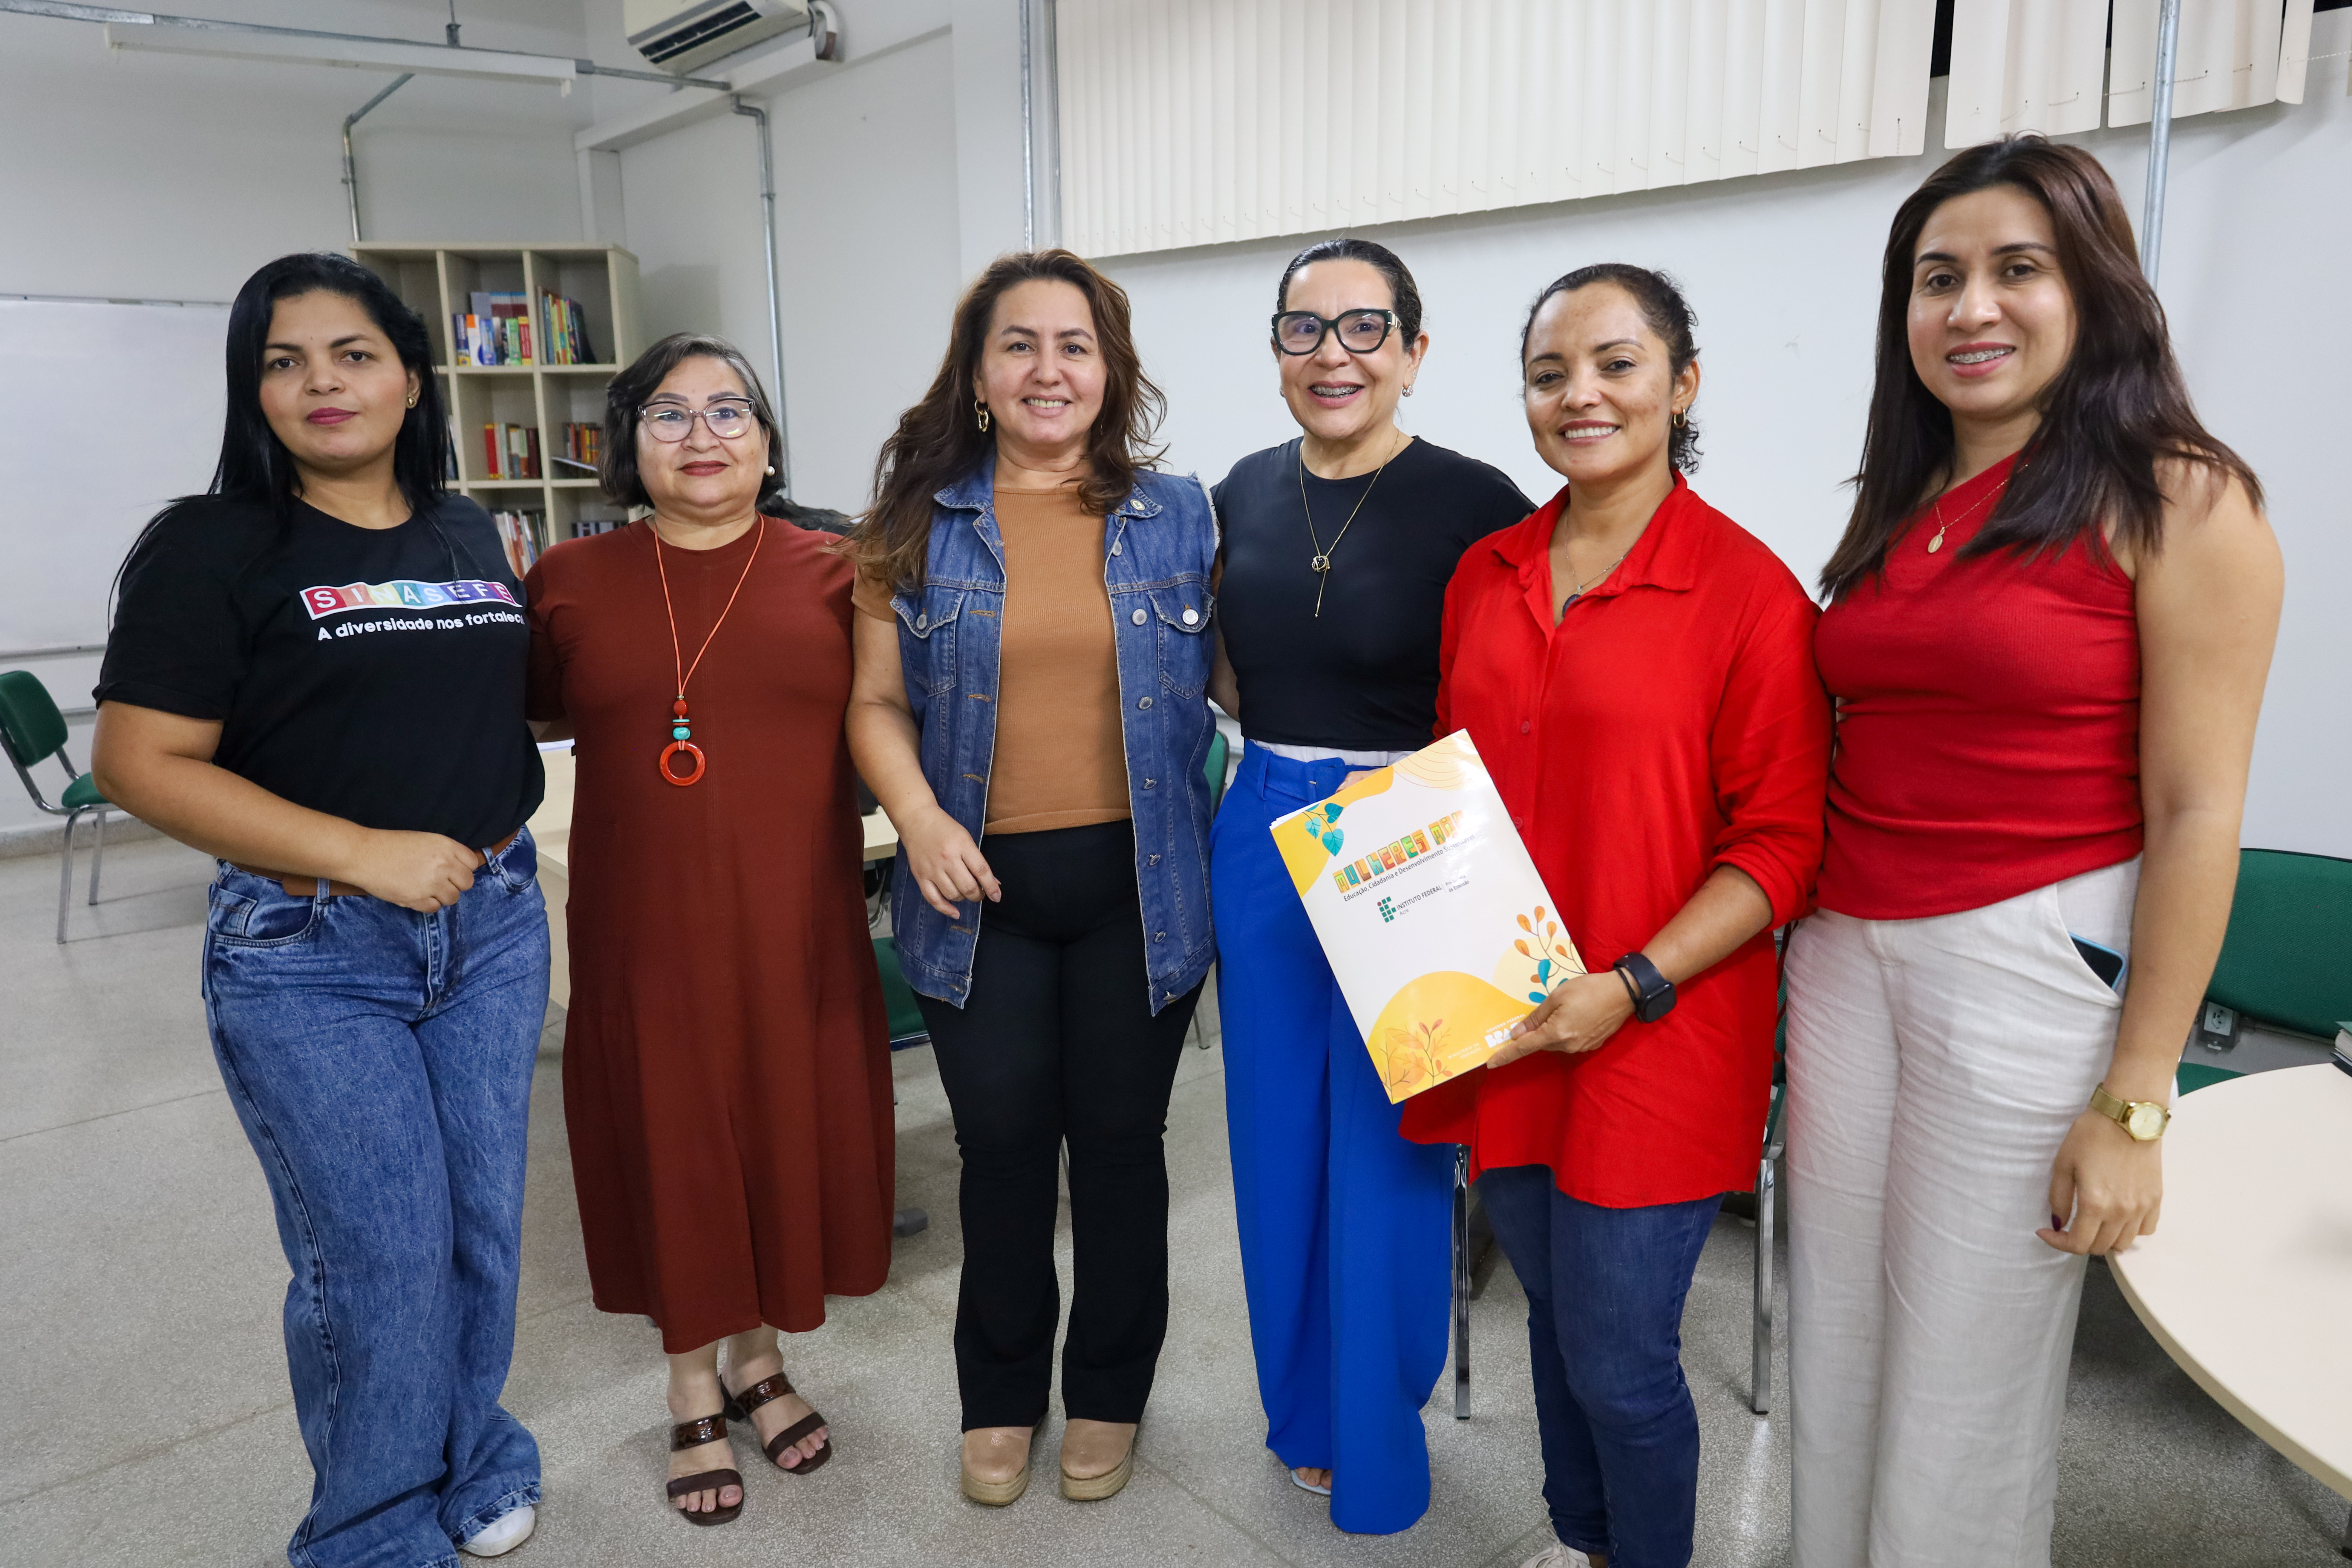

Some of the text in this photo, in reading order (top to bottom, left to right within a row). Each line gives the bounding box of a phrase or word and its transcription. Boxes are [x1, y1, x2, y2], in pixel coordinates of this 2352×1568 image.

[314, 583, 513, 608] SINASEFE
[318, 627, 332, 641] A
[335, 617, 433, 637] diversidade
[436, 619, 464, 629] nos
[1343, 887, 1369, 902] Educação,
[1368, 873, 1394, 889] Cidadania
[1398, 850, 1443, 874] Desenvolvimento
[1396, 885, 1442, 910] INSTITUTO FEDERAL
[1486, 1014, 1525, 1033] GOVERNO FEDERAL
